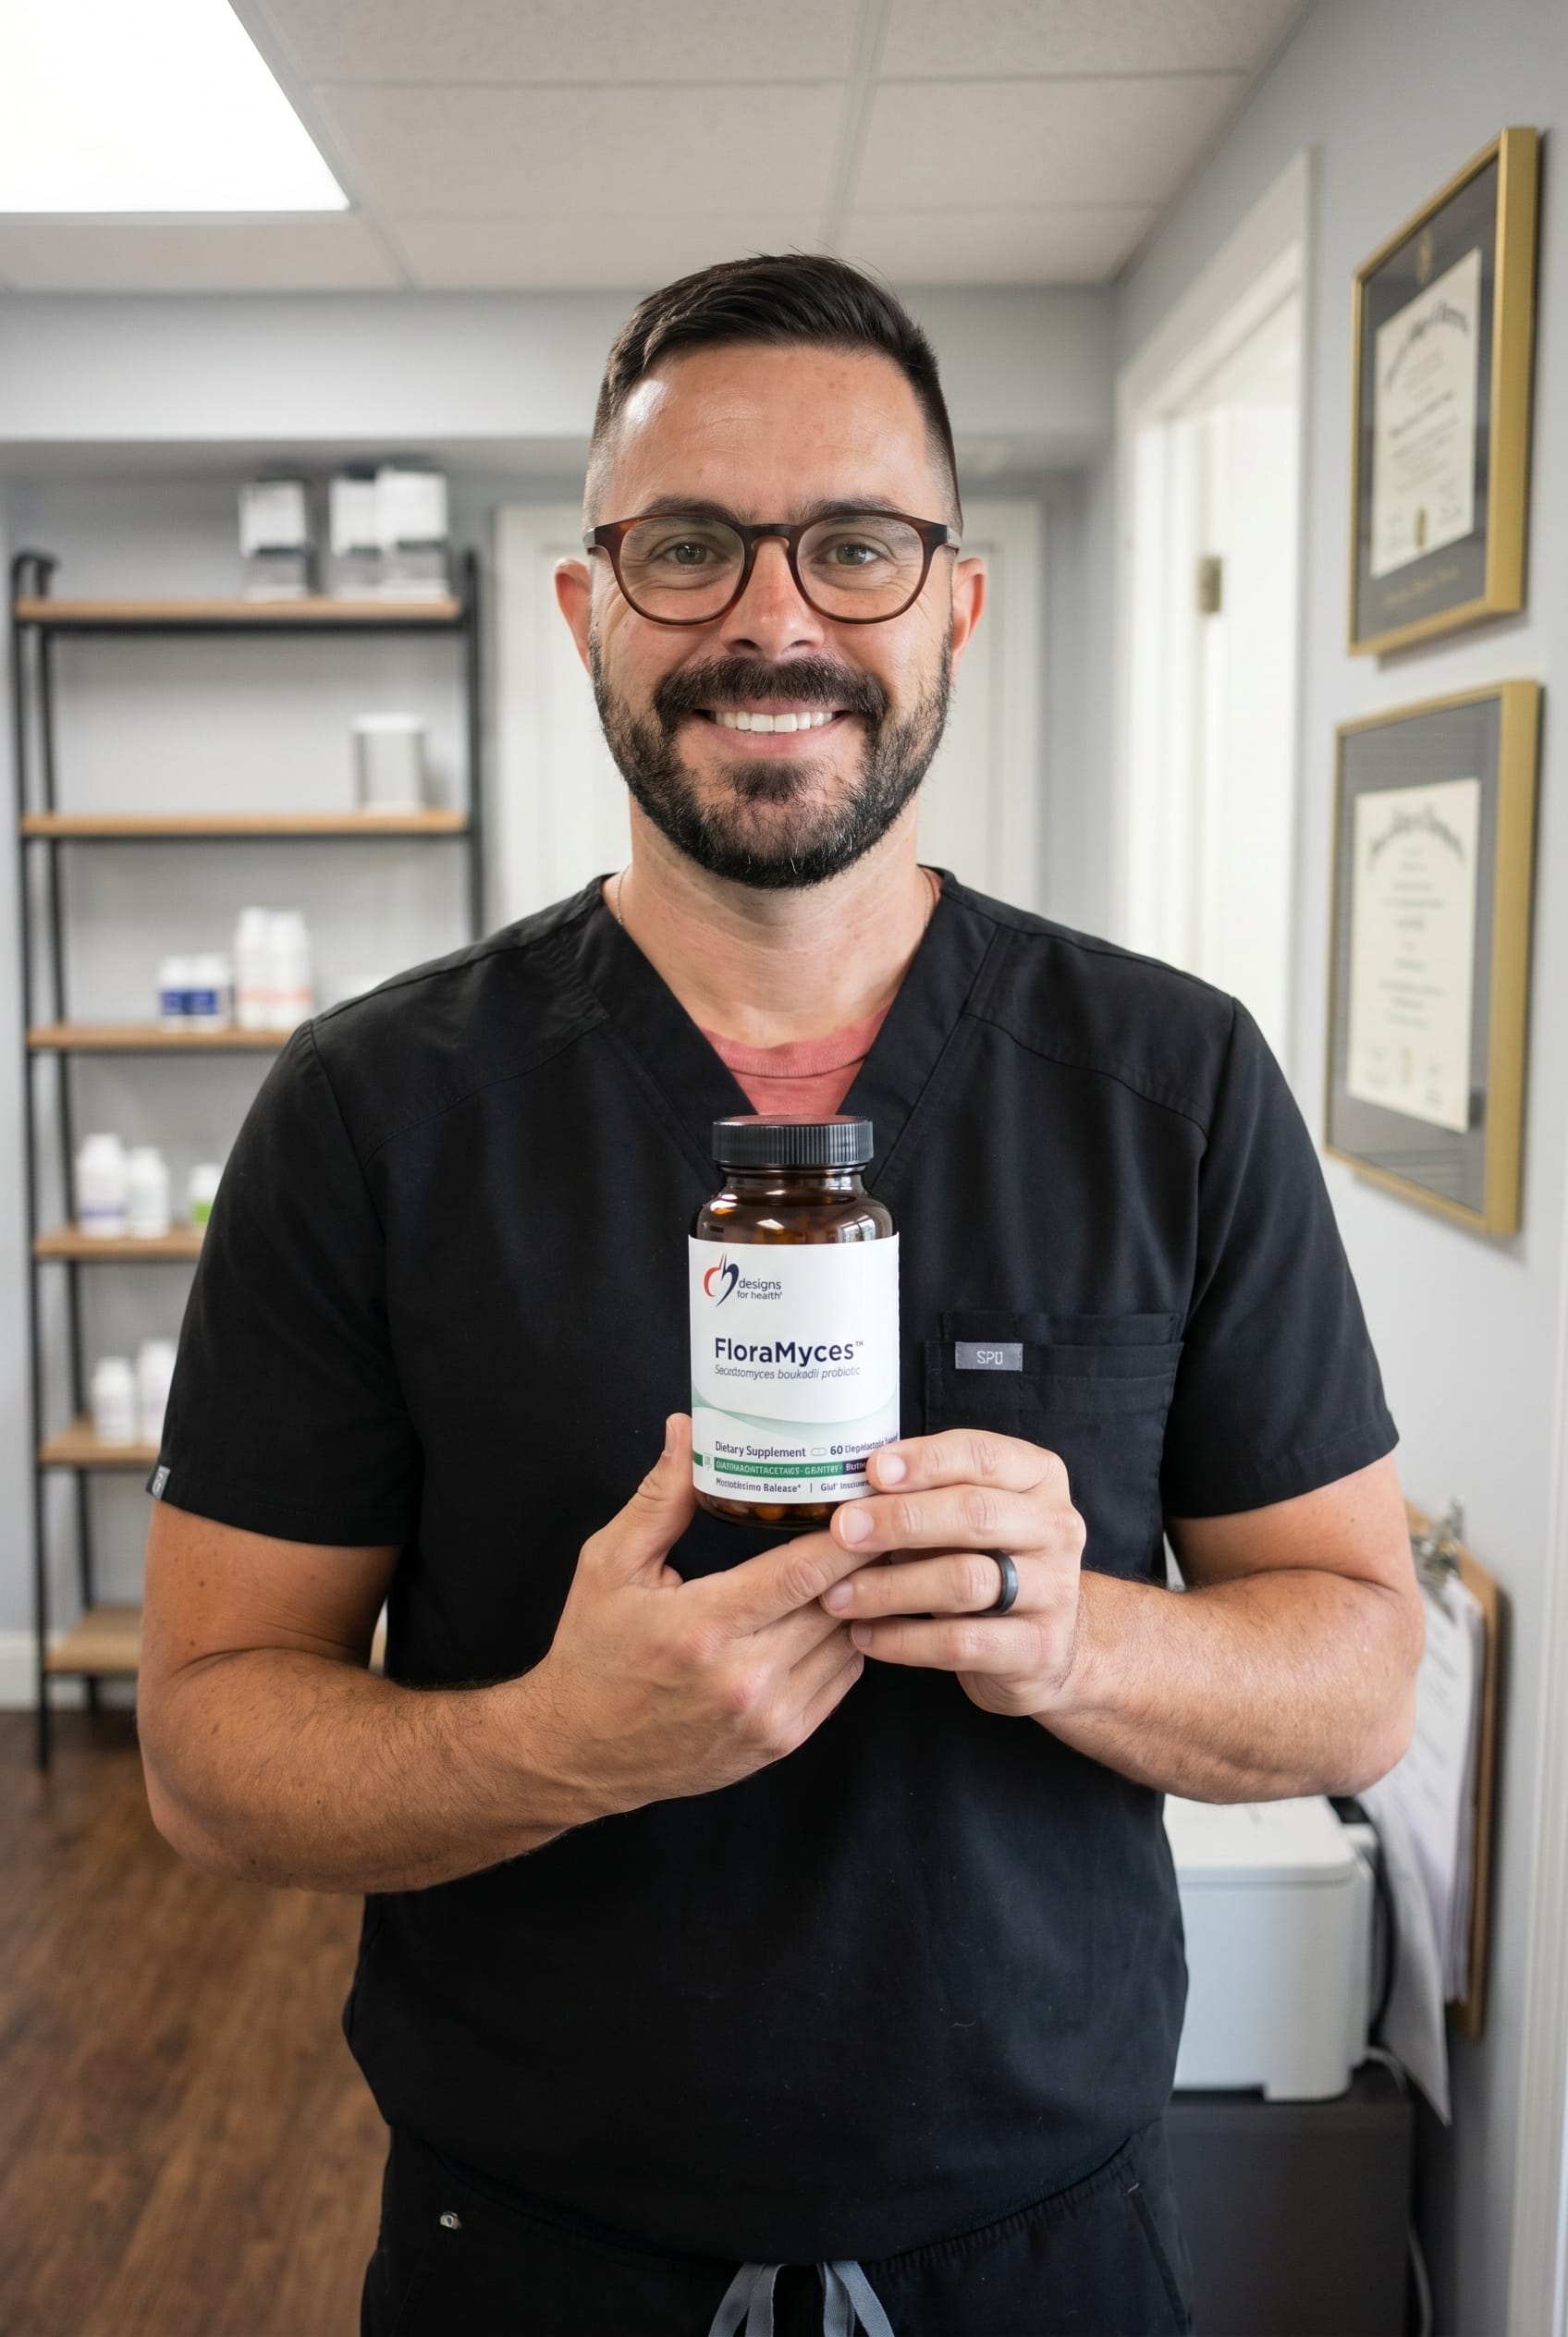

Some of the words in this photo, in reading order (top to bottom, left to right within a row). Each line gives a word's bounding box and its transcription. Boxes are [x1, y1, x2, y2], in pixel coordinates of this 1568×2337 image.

[739, 1278, 782, 1292] designs
[737, 1290, 749, 1299] for
[715, 1440, 744, 1457] Dietary
[746, 1446, 806, 1460] Supplement
[830, 1445, 843, 1455] 60
